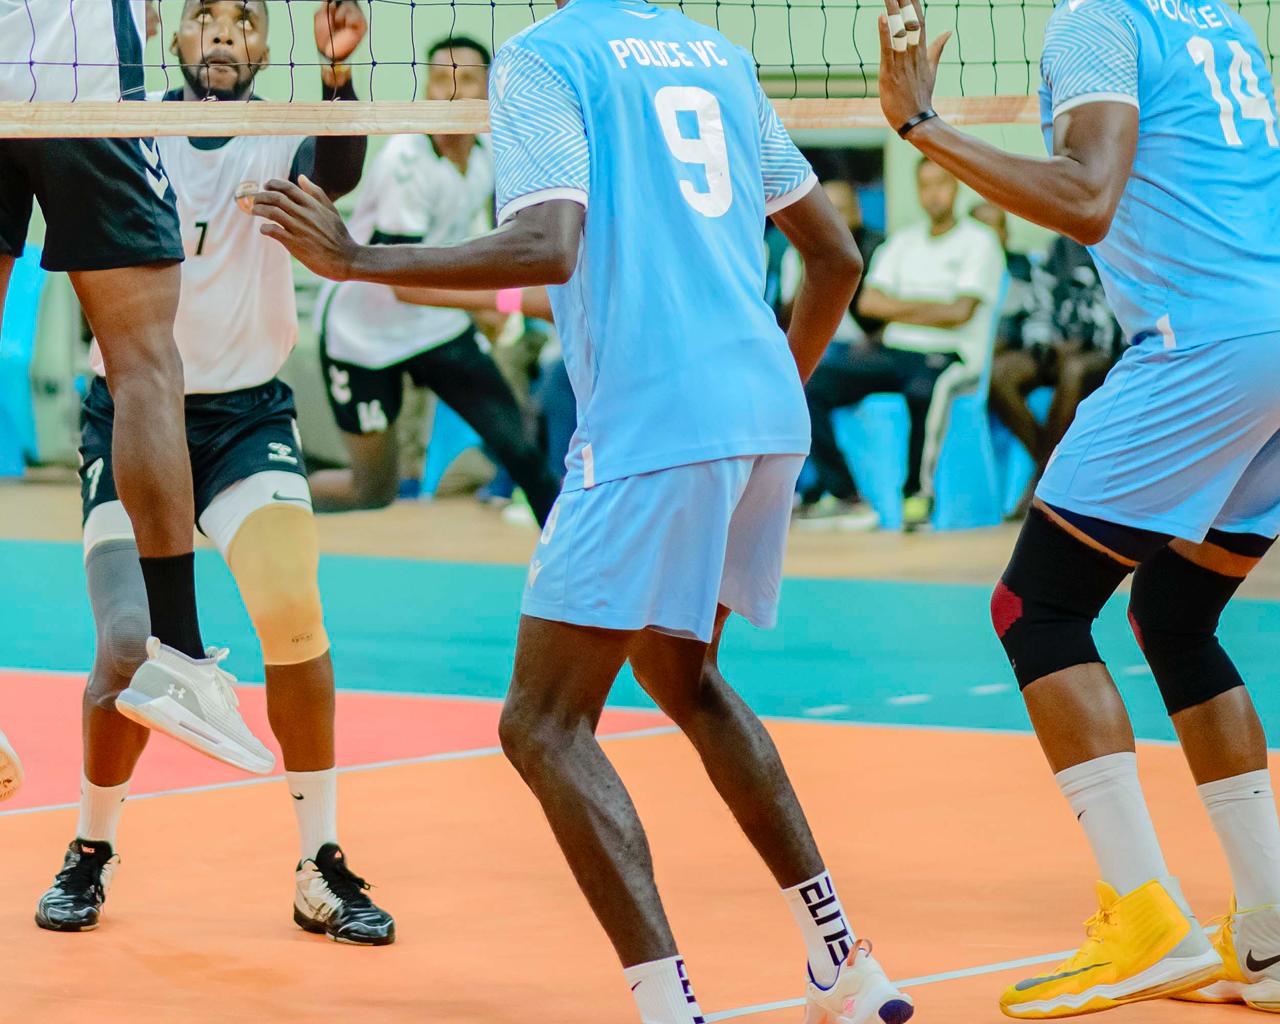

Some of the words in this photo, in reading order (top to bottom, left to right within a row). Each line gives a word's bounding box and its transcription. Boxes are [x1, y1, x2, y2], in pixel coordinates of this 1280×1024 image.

[608, 37, 695, 69] POLICE
[687, 39, 729, 68] VC
[1185, 35, 1280, 148] 14
[654, 85, 734, 219] 9
[194, 221, 208, 257] 7
